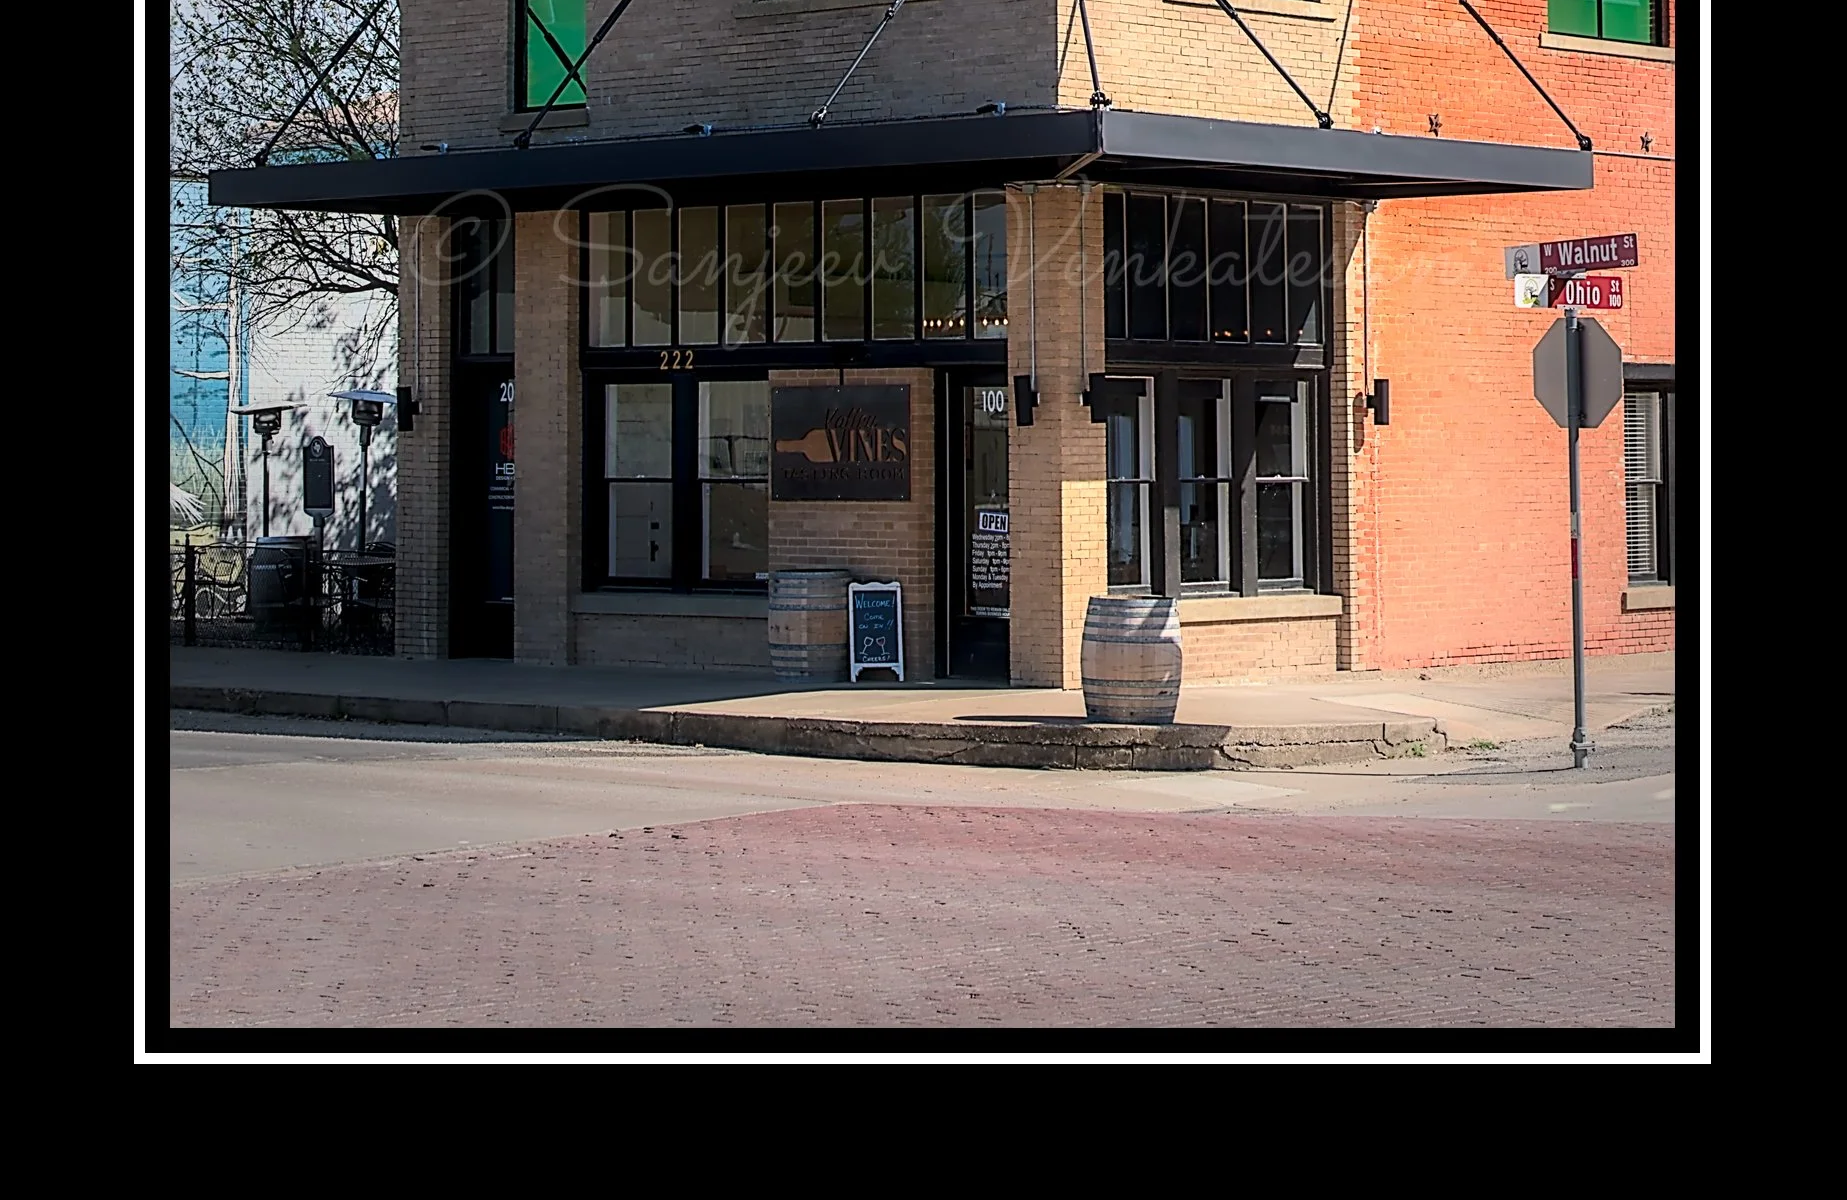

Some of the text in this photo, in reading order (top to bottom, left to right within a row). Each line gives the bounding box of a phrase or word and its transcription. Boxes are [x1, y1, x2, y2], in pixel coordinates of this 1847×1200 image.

[1543, 236, 1634, 266] W Walnut St
[1620, 259, 1635, 269] 300
[1544, 266, 1557, 275] 200
[1549, 279, 1620, 306] S Ohio St
[1609, 294, 1622, 307] 100
[659, 350, 694, 370] 222
[982, 390, 1004, 412] 100
[826, 428, 908, 463] VINES
[783, 467, 906, 481] TASTING ROOM
[982, 513, 1007, 531] OPEN
[972, 534, 995, 543] Wednesday
[972, 541, 990, 550] Thursday
[972, 549, 985, 558] Friday
[972, 557, 990, 566] Saturday
[972, 565, 988, 574] Sunday
[972, 573, 988, 582] Monday
[992, 573, 1009, 583] Tuesday
[972, 581, 1003, 590] By Appointment
